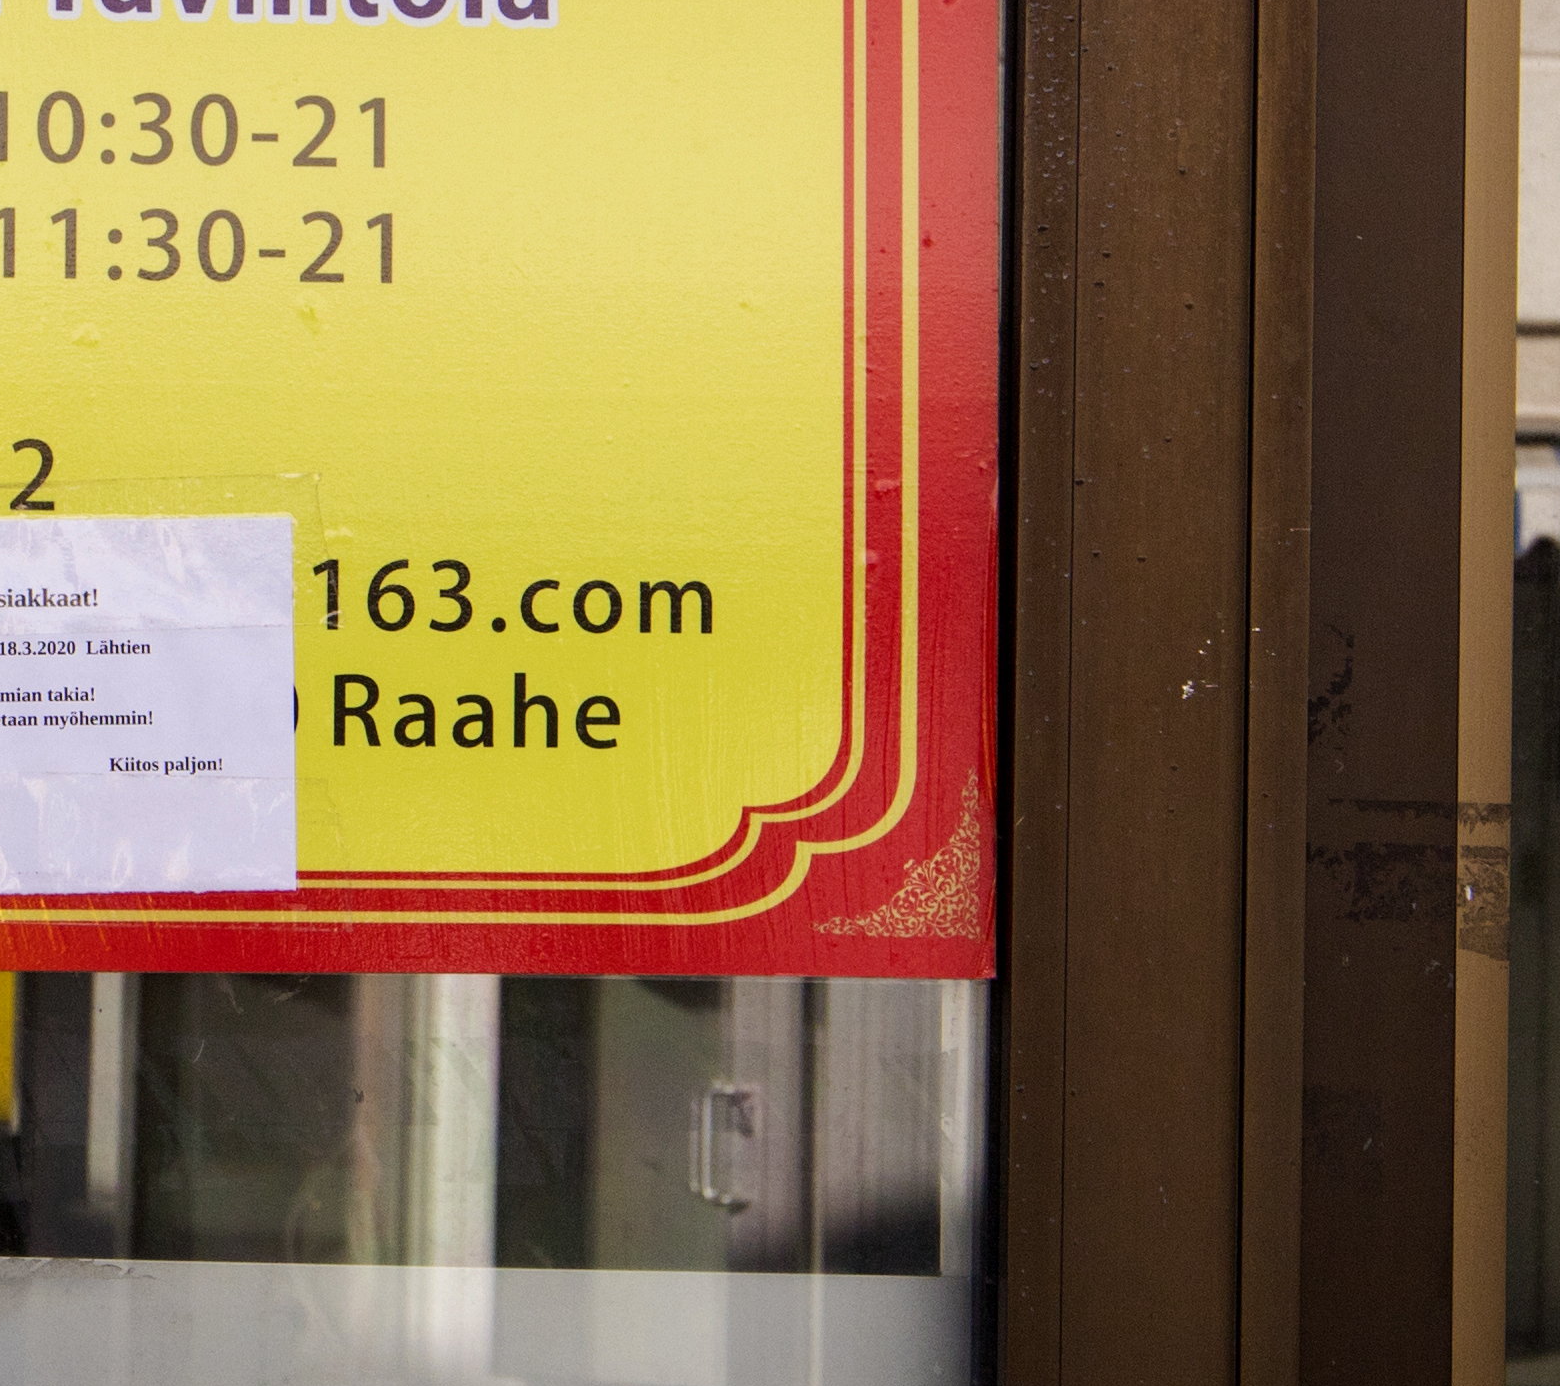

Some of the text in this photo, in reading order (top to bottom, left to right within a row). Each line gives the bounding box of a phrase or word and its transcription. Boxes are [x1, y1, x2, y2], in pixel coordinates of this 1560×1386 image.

[0, 640, 77, 657] 18.3.2020
[86, 639, 151, 656] Lähtien
[47, 686, 95, 703] takia!
[43, 709, 155, 730] myöhemmin!
[332, 671, 622, 751] Raahe
[109, 755, 223, 776] Kiitos paljon!
